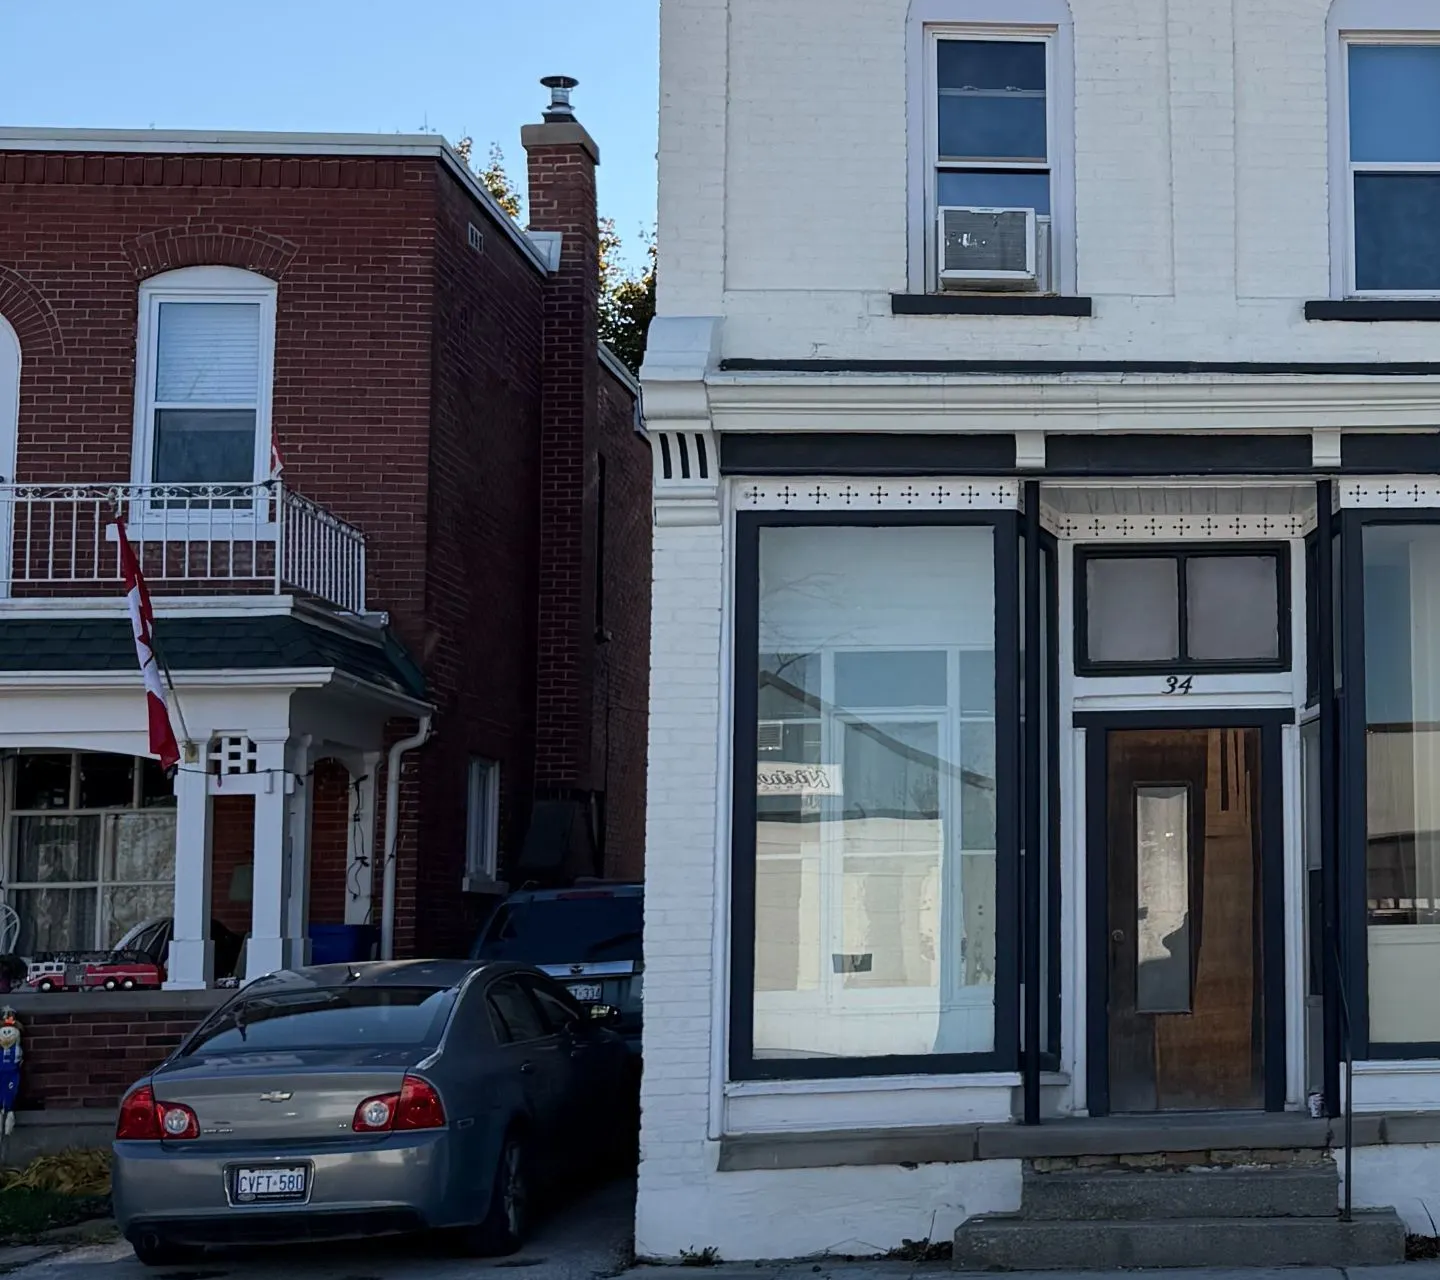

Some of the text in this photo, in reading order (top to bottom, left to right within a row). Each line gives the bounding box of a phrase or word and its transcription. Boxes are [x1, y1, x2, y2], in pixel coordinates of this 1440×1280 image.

[1161, 675, 1193, 695] 34
[239, 1174, 304, 1193] CVFT 580
